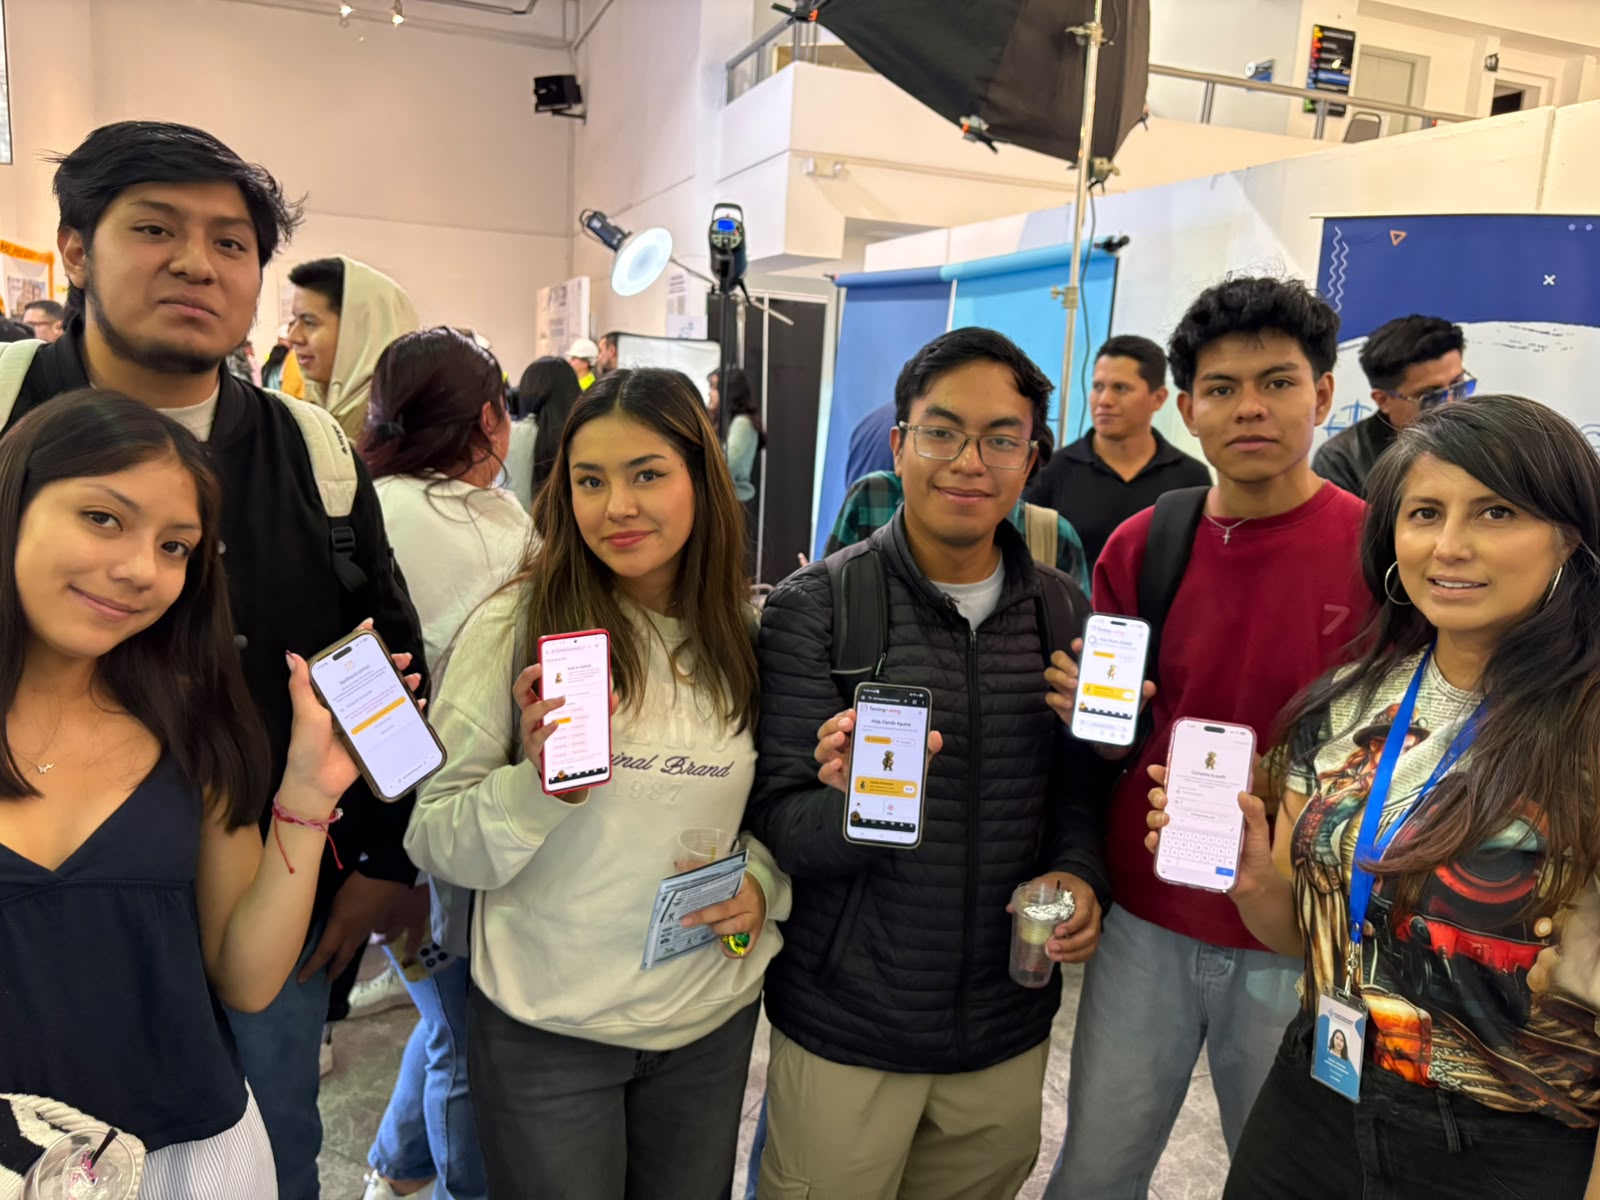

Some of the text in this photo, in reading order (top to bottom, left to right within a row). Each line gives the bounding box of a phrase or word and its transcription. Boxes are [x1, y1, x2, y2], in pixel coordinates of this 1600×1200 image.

[1322, 604, 1350, 635] 7
[611, 753, 735, 777] inal Brand
